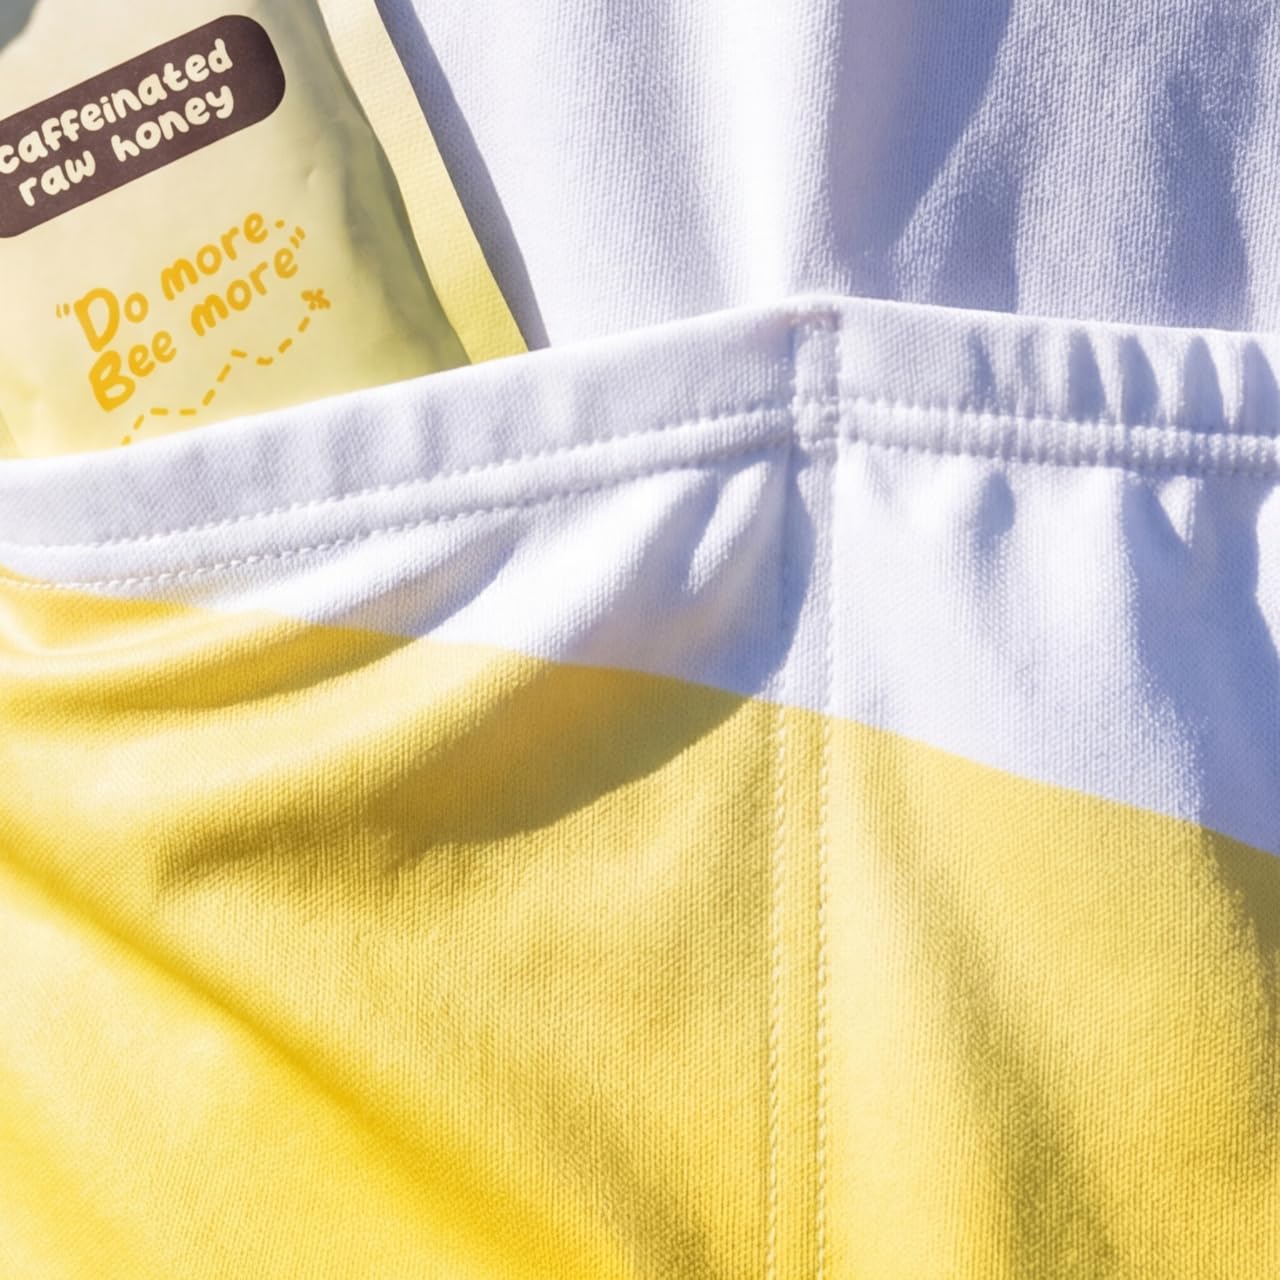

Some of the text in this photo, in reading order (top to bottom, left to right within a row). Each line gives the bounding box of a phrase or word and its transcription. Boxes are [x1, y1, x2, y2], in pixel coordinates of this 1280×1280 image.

[18, 85, 234, 207] raw honey
[160, 212, 286, 300] more.
[88, 330, 177, 412] Bee
